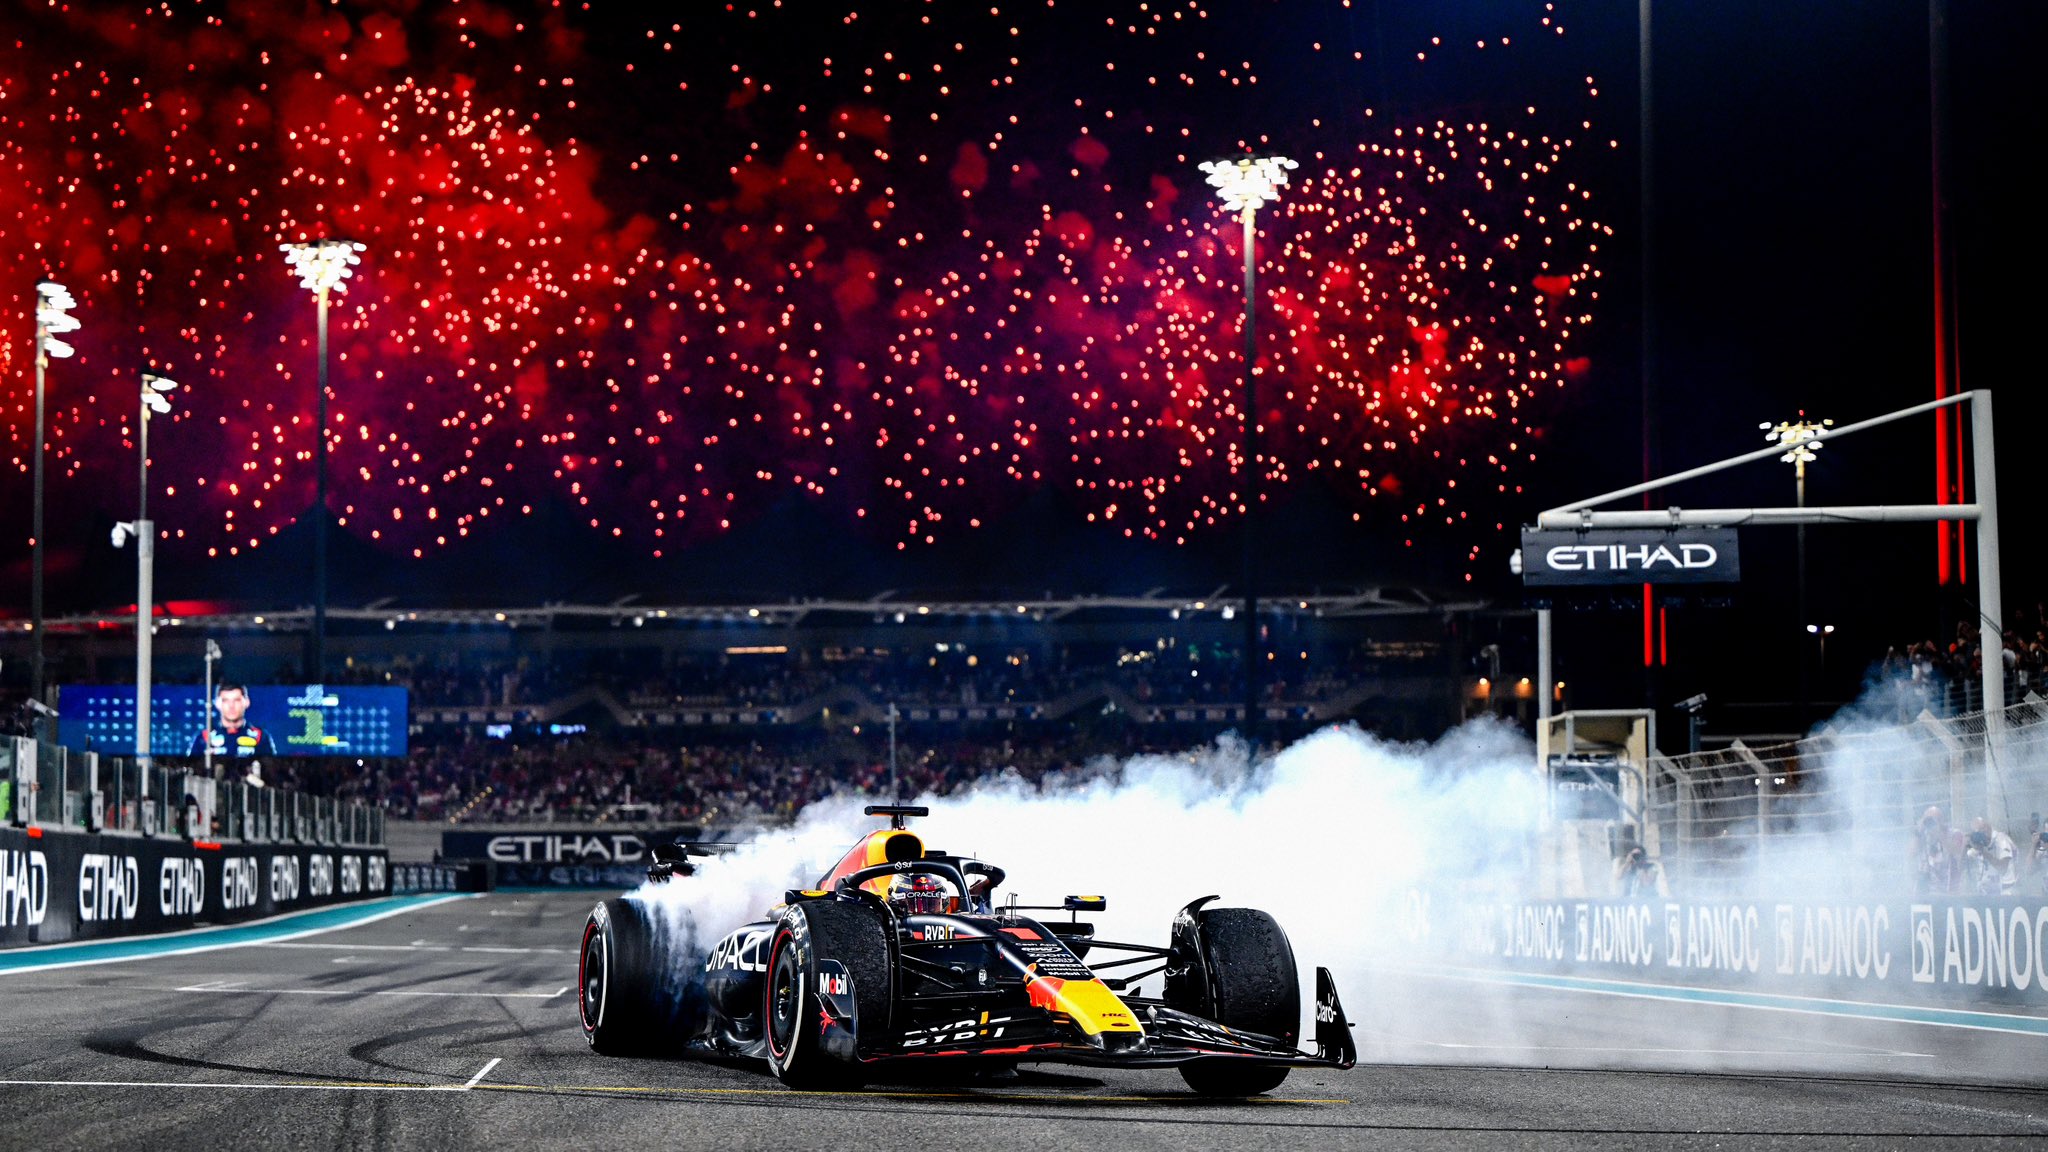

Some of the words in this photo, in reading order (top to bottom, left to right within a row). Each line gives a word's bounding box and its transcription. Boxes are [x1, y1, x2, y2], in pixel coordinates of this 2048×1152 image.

[1546, 543, 1717, 571] ETIHAD
[487, 835, 646, 862] ETIHAD
[79, 853, 139, 922] ETIHAD
[160, 857, 204, 916] ETIHAD
[223, 857, 258, 909] ETIHAD
[906, 891, 941, 899] ORACLE
[1515, 904, 1565, 961] ADNOC
[1591, 904, 1652, 966] ADNOC
[1686, 905, 1760, 972] ADNOC
[1800, 904, 1891, 980] ADNOC
[819, 972, 847, 995] Mobil
